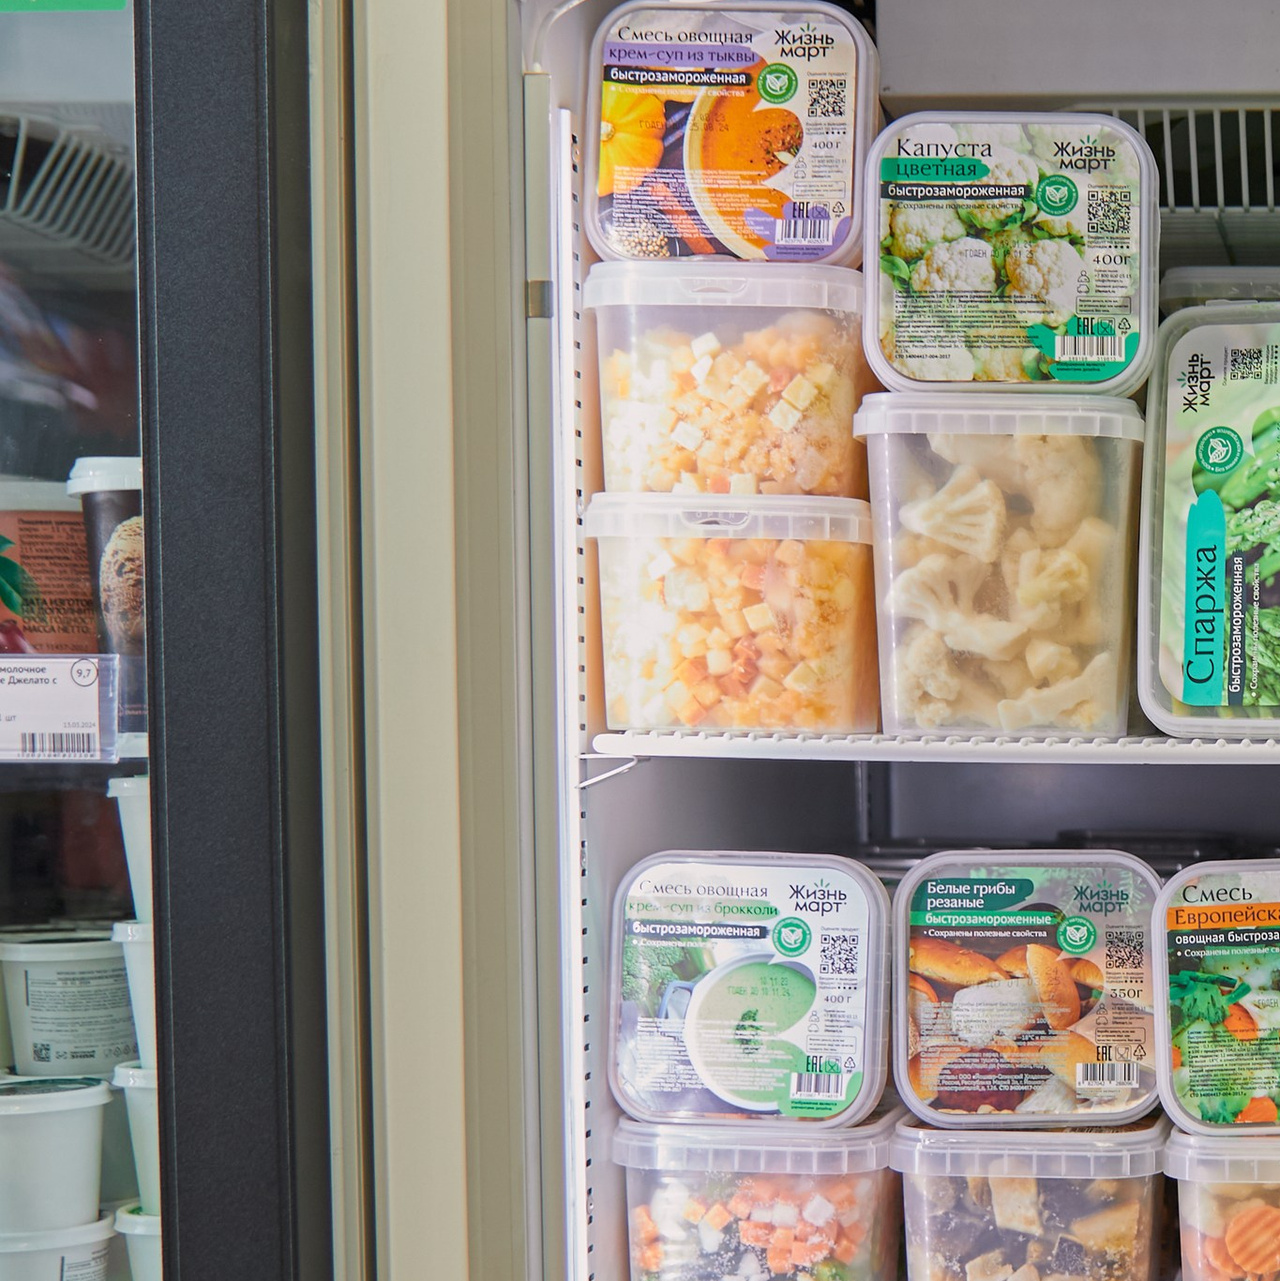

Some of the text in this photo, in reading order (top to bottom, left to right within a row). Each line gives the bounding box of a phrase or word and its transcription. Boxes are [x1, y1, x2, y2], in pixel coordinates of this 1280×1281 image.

[618, 26, 753, 45] Смесь овощная
[775, 29, 834, 46] Жизнь
[609, 48, 755, 64] крем-суп из тыквы
[780, 45, 829, 62] март
[610, 68, 746, 85] быстрозамороженная
[812, 141, 834, 150] 400
[897, 138, 993, 162] Капуста
[1053, 142, 1116, 158] Жизнь
[896, 163, 977, 178] цветная
[1059, 157, 1111, 174] март
[888, 184, 1025, 199] быстрозамороженная
[792, 202, 810, 218] EAC
[897, 202, 944, 211] Сохранены
[964, 250, 987, 258] ГОДЕН
[1093, 254, 1131, 266] 400г
[1077, 317, 1095, 335] EAC
[1183, 353, 1199, 413] Жизнь
[1199, 357, 1215, 407] март
[1252, 562, 1260, 641] полезные свойства
[1186, 544, 1224, 684] Спаржа
[1229, 556, 1244, 693] быстрозамороженная
[8, 676, 50, 685] Джелато
[76, 669, 91, 678] 9,7
[639, 880, 768, 900] Смесь овощная
[789, 885, 847, 901] Жизнь
[927, 882, 1015, 897] Белые грибы
[1074, 886, 1129, 901] Жизнь
[1182, 885, 1252, 904] Смесь
[714, 902, 778, 917] брокколи
[794, 901, 842, 916] март
[927, 898, 984, 910] резаные
[1079, 900, 1125, 916] март
[925, 913, 1052, 926] быстрозамороженные
[632, 921, 760, 936] быстрозамороженная
[928, 929, 973, 938] Сохранены
[1012, 929, 1047, 937] свойства
[1176, 932, 1225, 945] овощная
[1184, 949, 1230, 957] Сохранены
[1231, 947, 1269, 955] полезные
[824, 995, 845, 1004] 400
[1110, 988, 1143, 998] 350г
[1097, 1046, 1112, 1061] EAC
[806, 1056, 823, 1072] EAC
